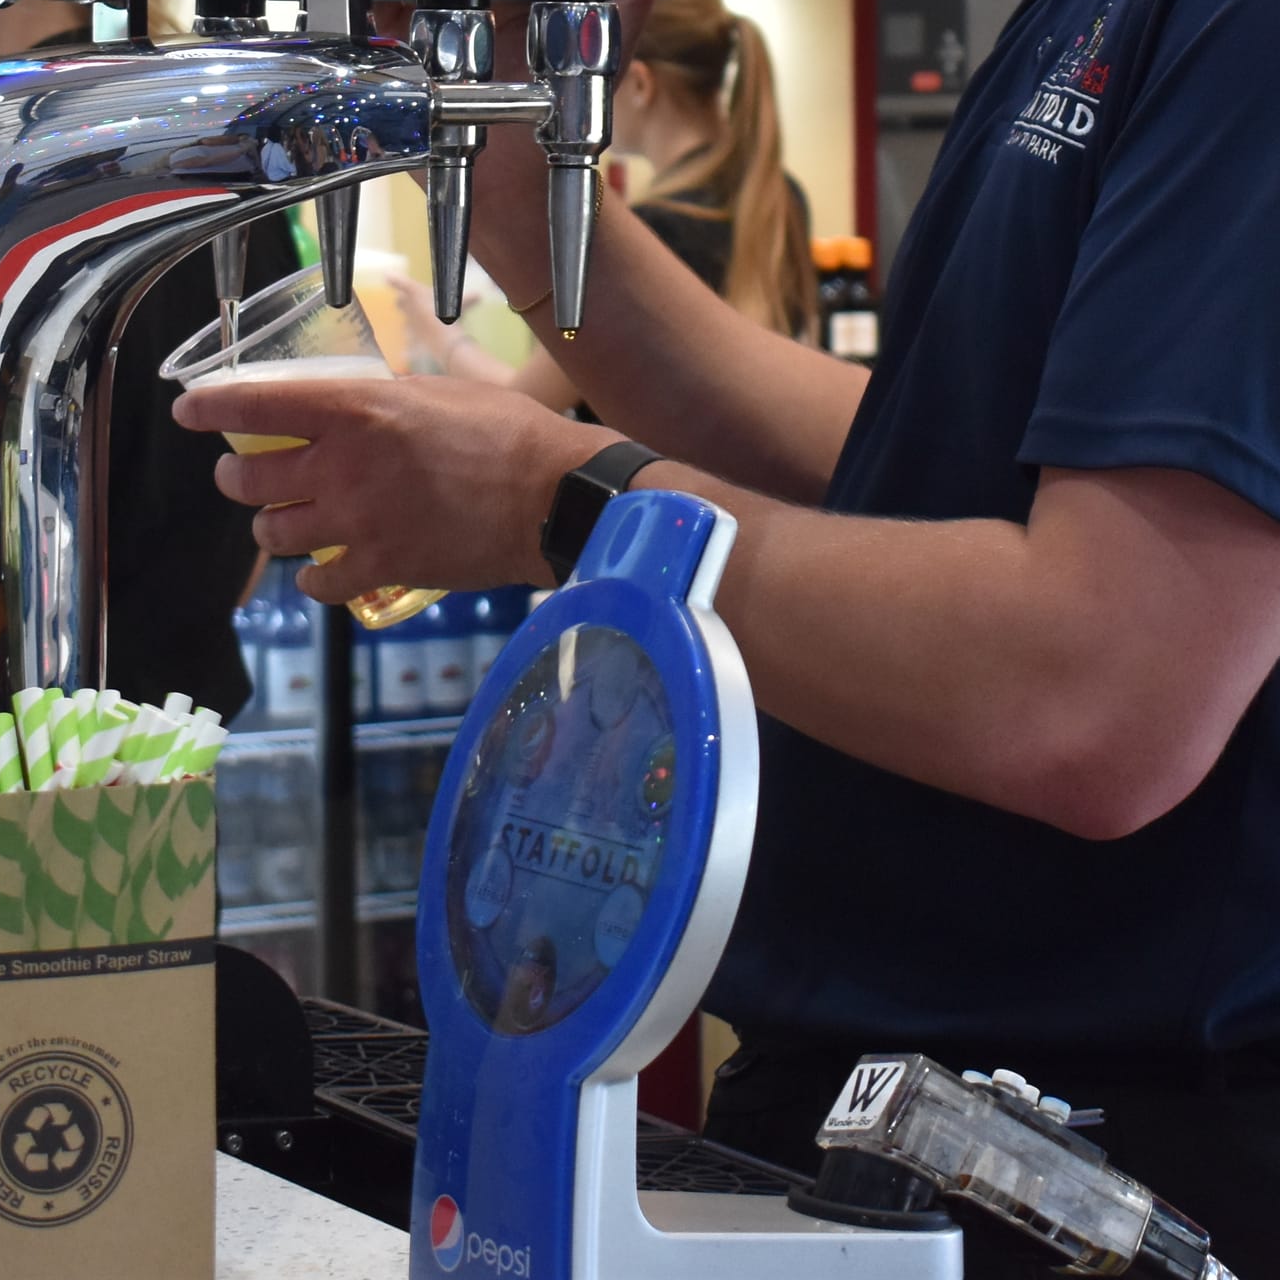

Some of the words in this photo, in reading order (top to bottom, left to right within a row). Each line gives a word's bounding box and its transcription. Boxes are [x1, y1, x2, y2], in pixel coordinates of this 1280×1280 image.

[1026, 134, 1063, 165] PARK
[11, 953, 92, 976] Smoothie
[96, 952, 143, 971] Paper
[148, 947, 192, 965] Straw
[6, 1042, 25, 1057] for
[27, 1037, 47, 1049] the
[49, 1036, 122, 1069] environment
[8, 1065, 94, 1094] RECYCLE
[76, 1135, 121, 1201] REUSE
[466, 1231, 531, 1280] pepsi
